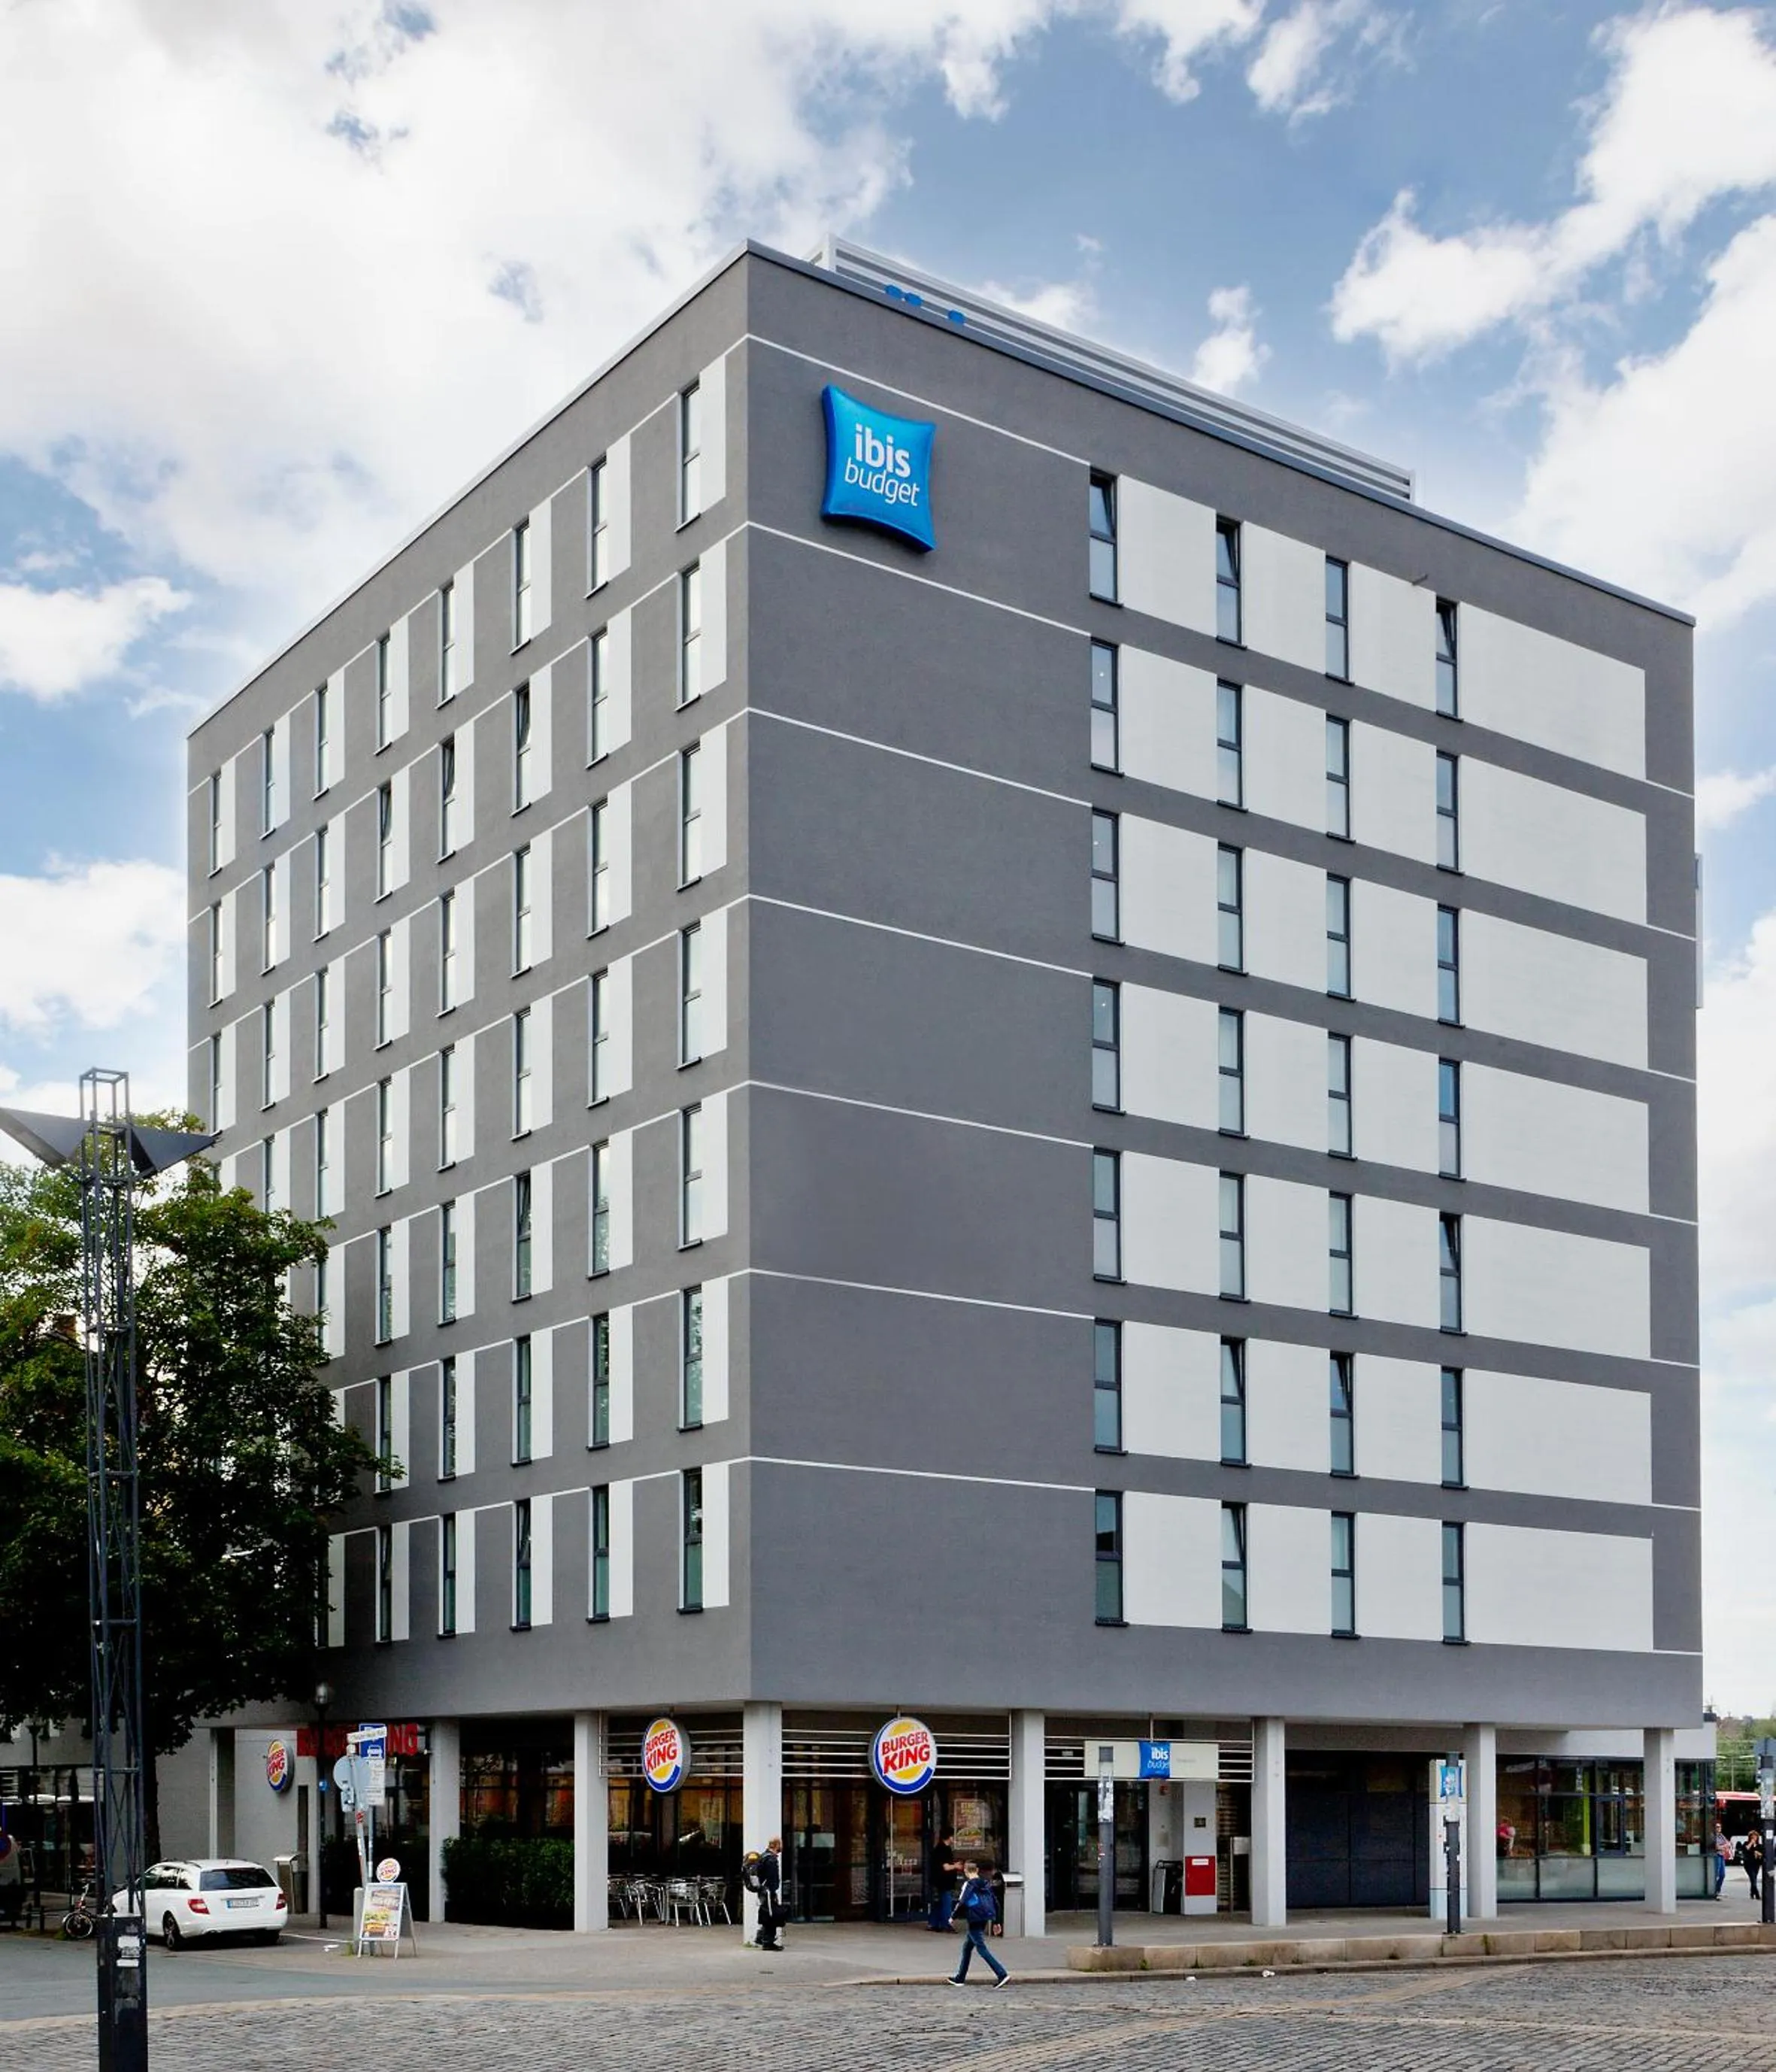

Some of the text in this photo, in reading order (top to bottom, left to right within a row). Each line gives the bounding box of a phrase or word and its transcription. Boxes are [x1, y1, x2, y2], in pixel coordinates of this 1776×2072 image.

[856, 423, 911, 478] ibis
[844, 457, 920, 506] budget
[647, 1729, 676, 1755] BURGER
[882, 1731, 929, 1756] BURGER
[1151, 1747, 1168, 1760] ibis
[647, 1743, 677, 1770] KING
[883, 1744, 930, 1773] KING
